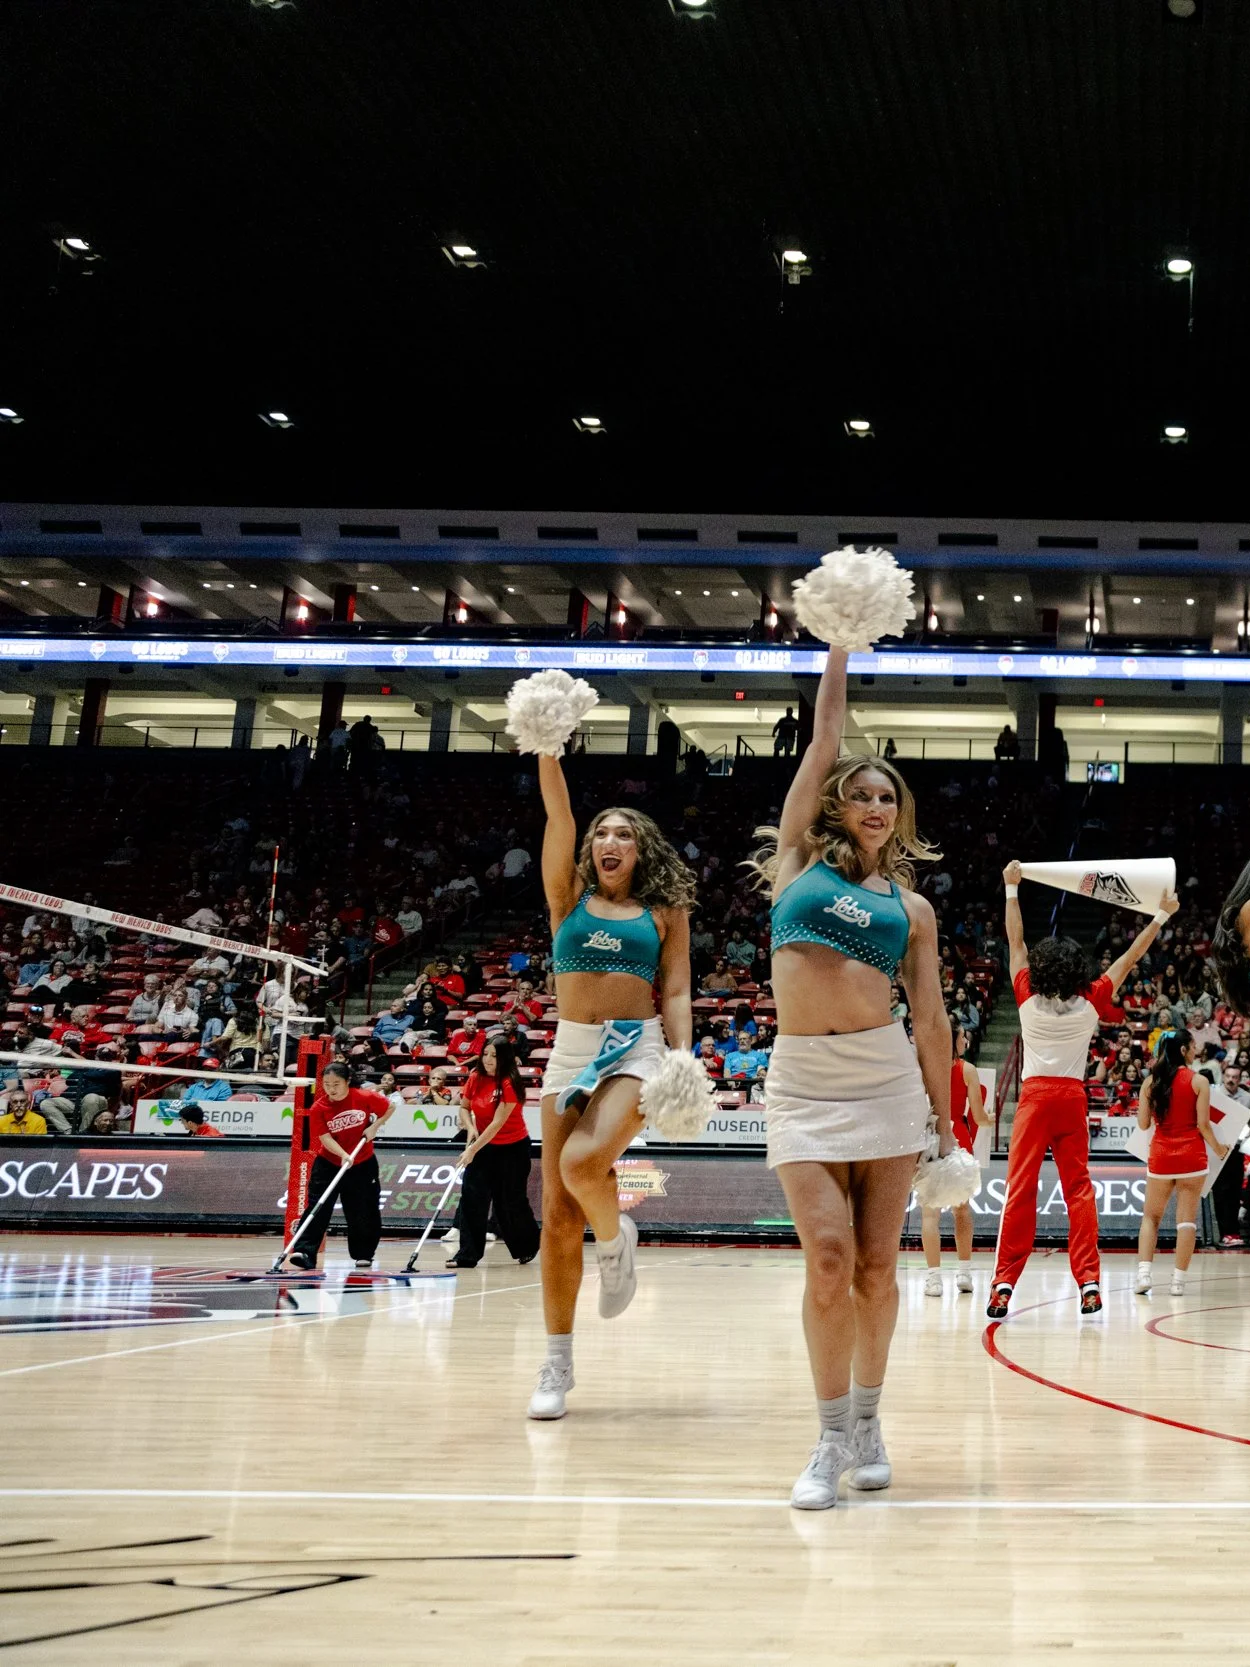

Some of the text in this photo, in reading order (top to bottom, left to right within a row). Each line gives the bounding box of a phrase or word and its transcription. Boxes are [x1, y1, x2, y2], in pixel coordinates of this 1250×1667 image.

[40, 896, 64, 909] LOBOS
[823, 895, 873, 928] Lobos
[110, 912, 126, 924] NEW
[582, 930, 622, 952] Lobos
[0, 1160, 168, 1200] SCAPES
[300, 1161, 308, 1185] sports
[622, 1181, 655, 1189] CHOICE
